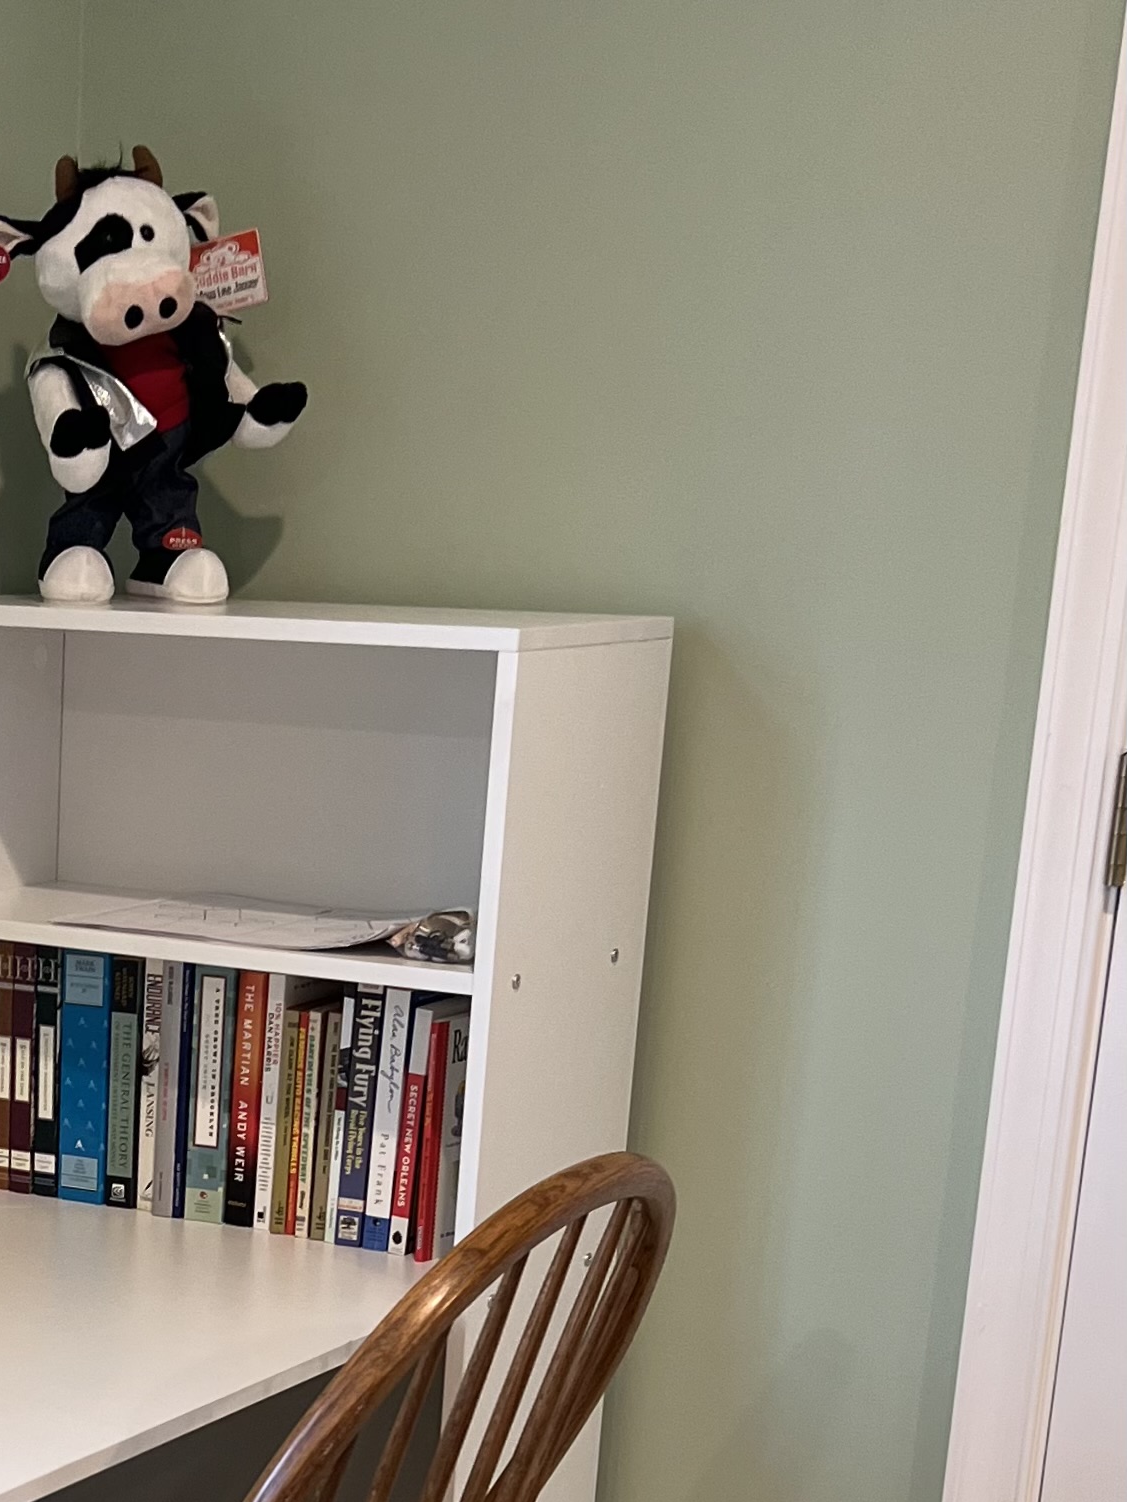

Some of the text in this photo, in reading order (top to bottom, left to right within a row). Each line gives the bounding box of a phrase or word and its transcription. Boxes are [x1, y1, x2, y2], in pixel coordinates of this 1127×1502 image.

[145, 973, 163, 1137] ENDURANCE LANSING
[265, 1036, 273, 1072] HARRIS
[272, 1023, 281, 1065] HAPPIER
[348, 998, 382, 1107] Flying Fury
[380, 1043, 401, 1113] Babylon
[118, 1022, 132, 1169] THE GENERAL THEORY
[208, 1085, 216, 1137] BROOKLYN
[234, 985, 255, 1182] THE MARTIAN ANDY WEIR
[344, 1152, 354, 1175] Corps
[347, 1129, 357, 1150] Flying
[355, 1157, 364, 1169] the
[374, 1133, 389, 1204] Pat Frank
[397, 1085, 418, 1207] SECRET NEW ORLEANS
